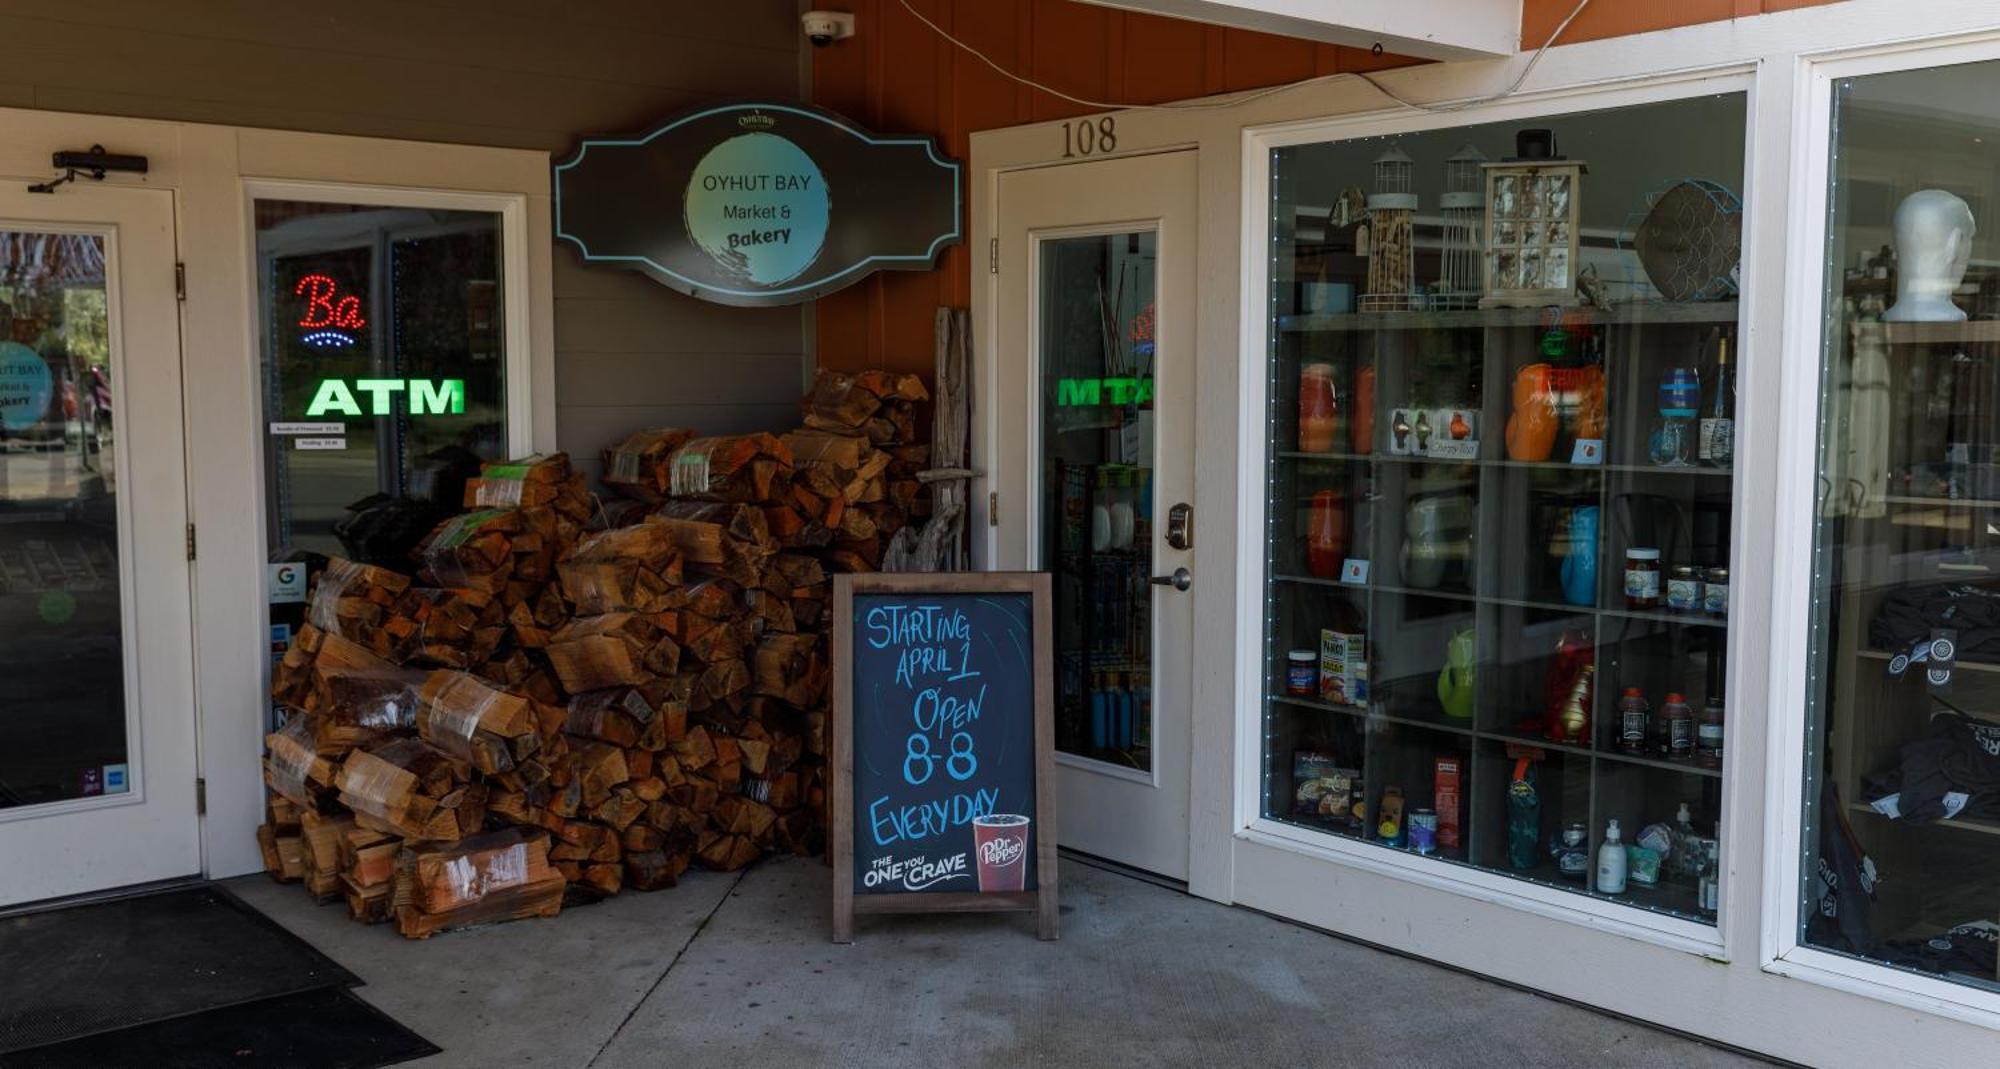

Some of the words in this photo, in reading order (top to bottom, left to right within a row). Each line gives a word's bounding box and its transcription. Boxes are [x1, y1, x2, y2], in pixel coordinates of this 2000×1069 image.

[1061, 115, 1117, 159] 108
[703, 174, 769, 192] OYHUT
[774, 174, 812, 192] BAY
[723, 203, 776, 221] Market
[780, 204, 791, 219] &
[727, 225, 791, 250] Bakery
[305, 378, 465, 417] ATM
[947, 641, 981, 682] 1
[903, 731, 978, 785] 8-8
[983, 841, 1021, 865] Pepper
[993, 837, 1010, 850] Dr
[871, 855, 893, 869] THE
[903, 855, 925, 869] YOU
[908, 852, 968, 884] CRAVE
[863, 862, 903, 889] ONE
